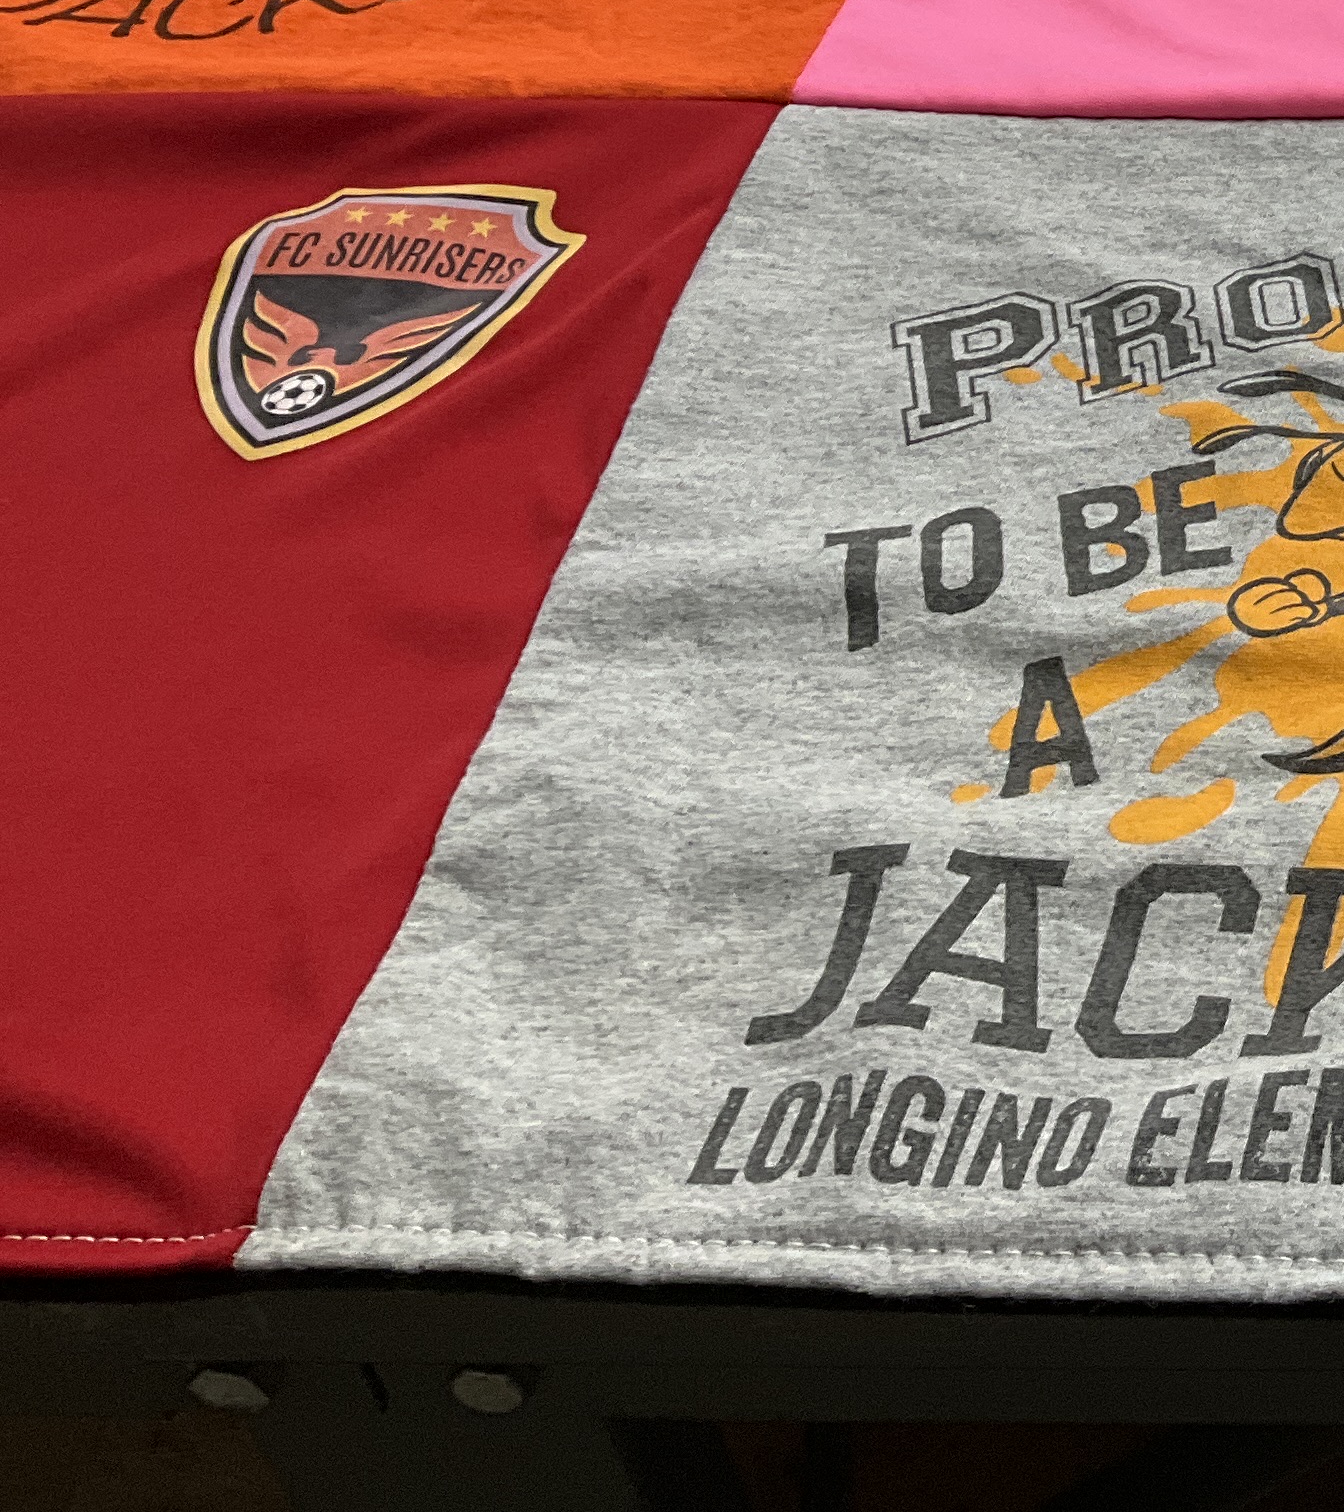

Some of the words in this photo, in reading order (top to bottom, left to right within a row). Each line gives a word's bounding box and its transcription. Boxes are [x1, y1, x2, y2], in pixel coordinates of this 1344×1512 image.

[266, 232, 321, 268] FC
[325, 233, 526, 285] SUNRISERS
[824, 505, 1001, 652] TO
[1058, 458, 1234, 598] BE
[1000, 654, 1100, 798] A
[686, 1068, 1114, 1190] LONGINO
